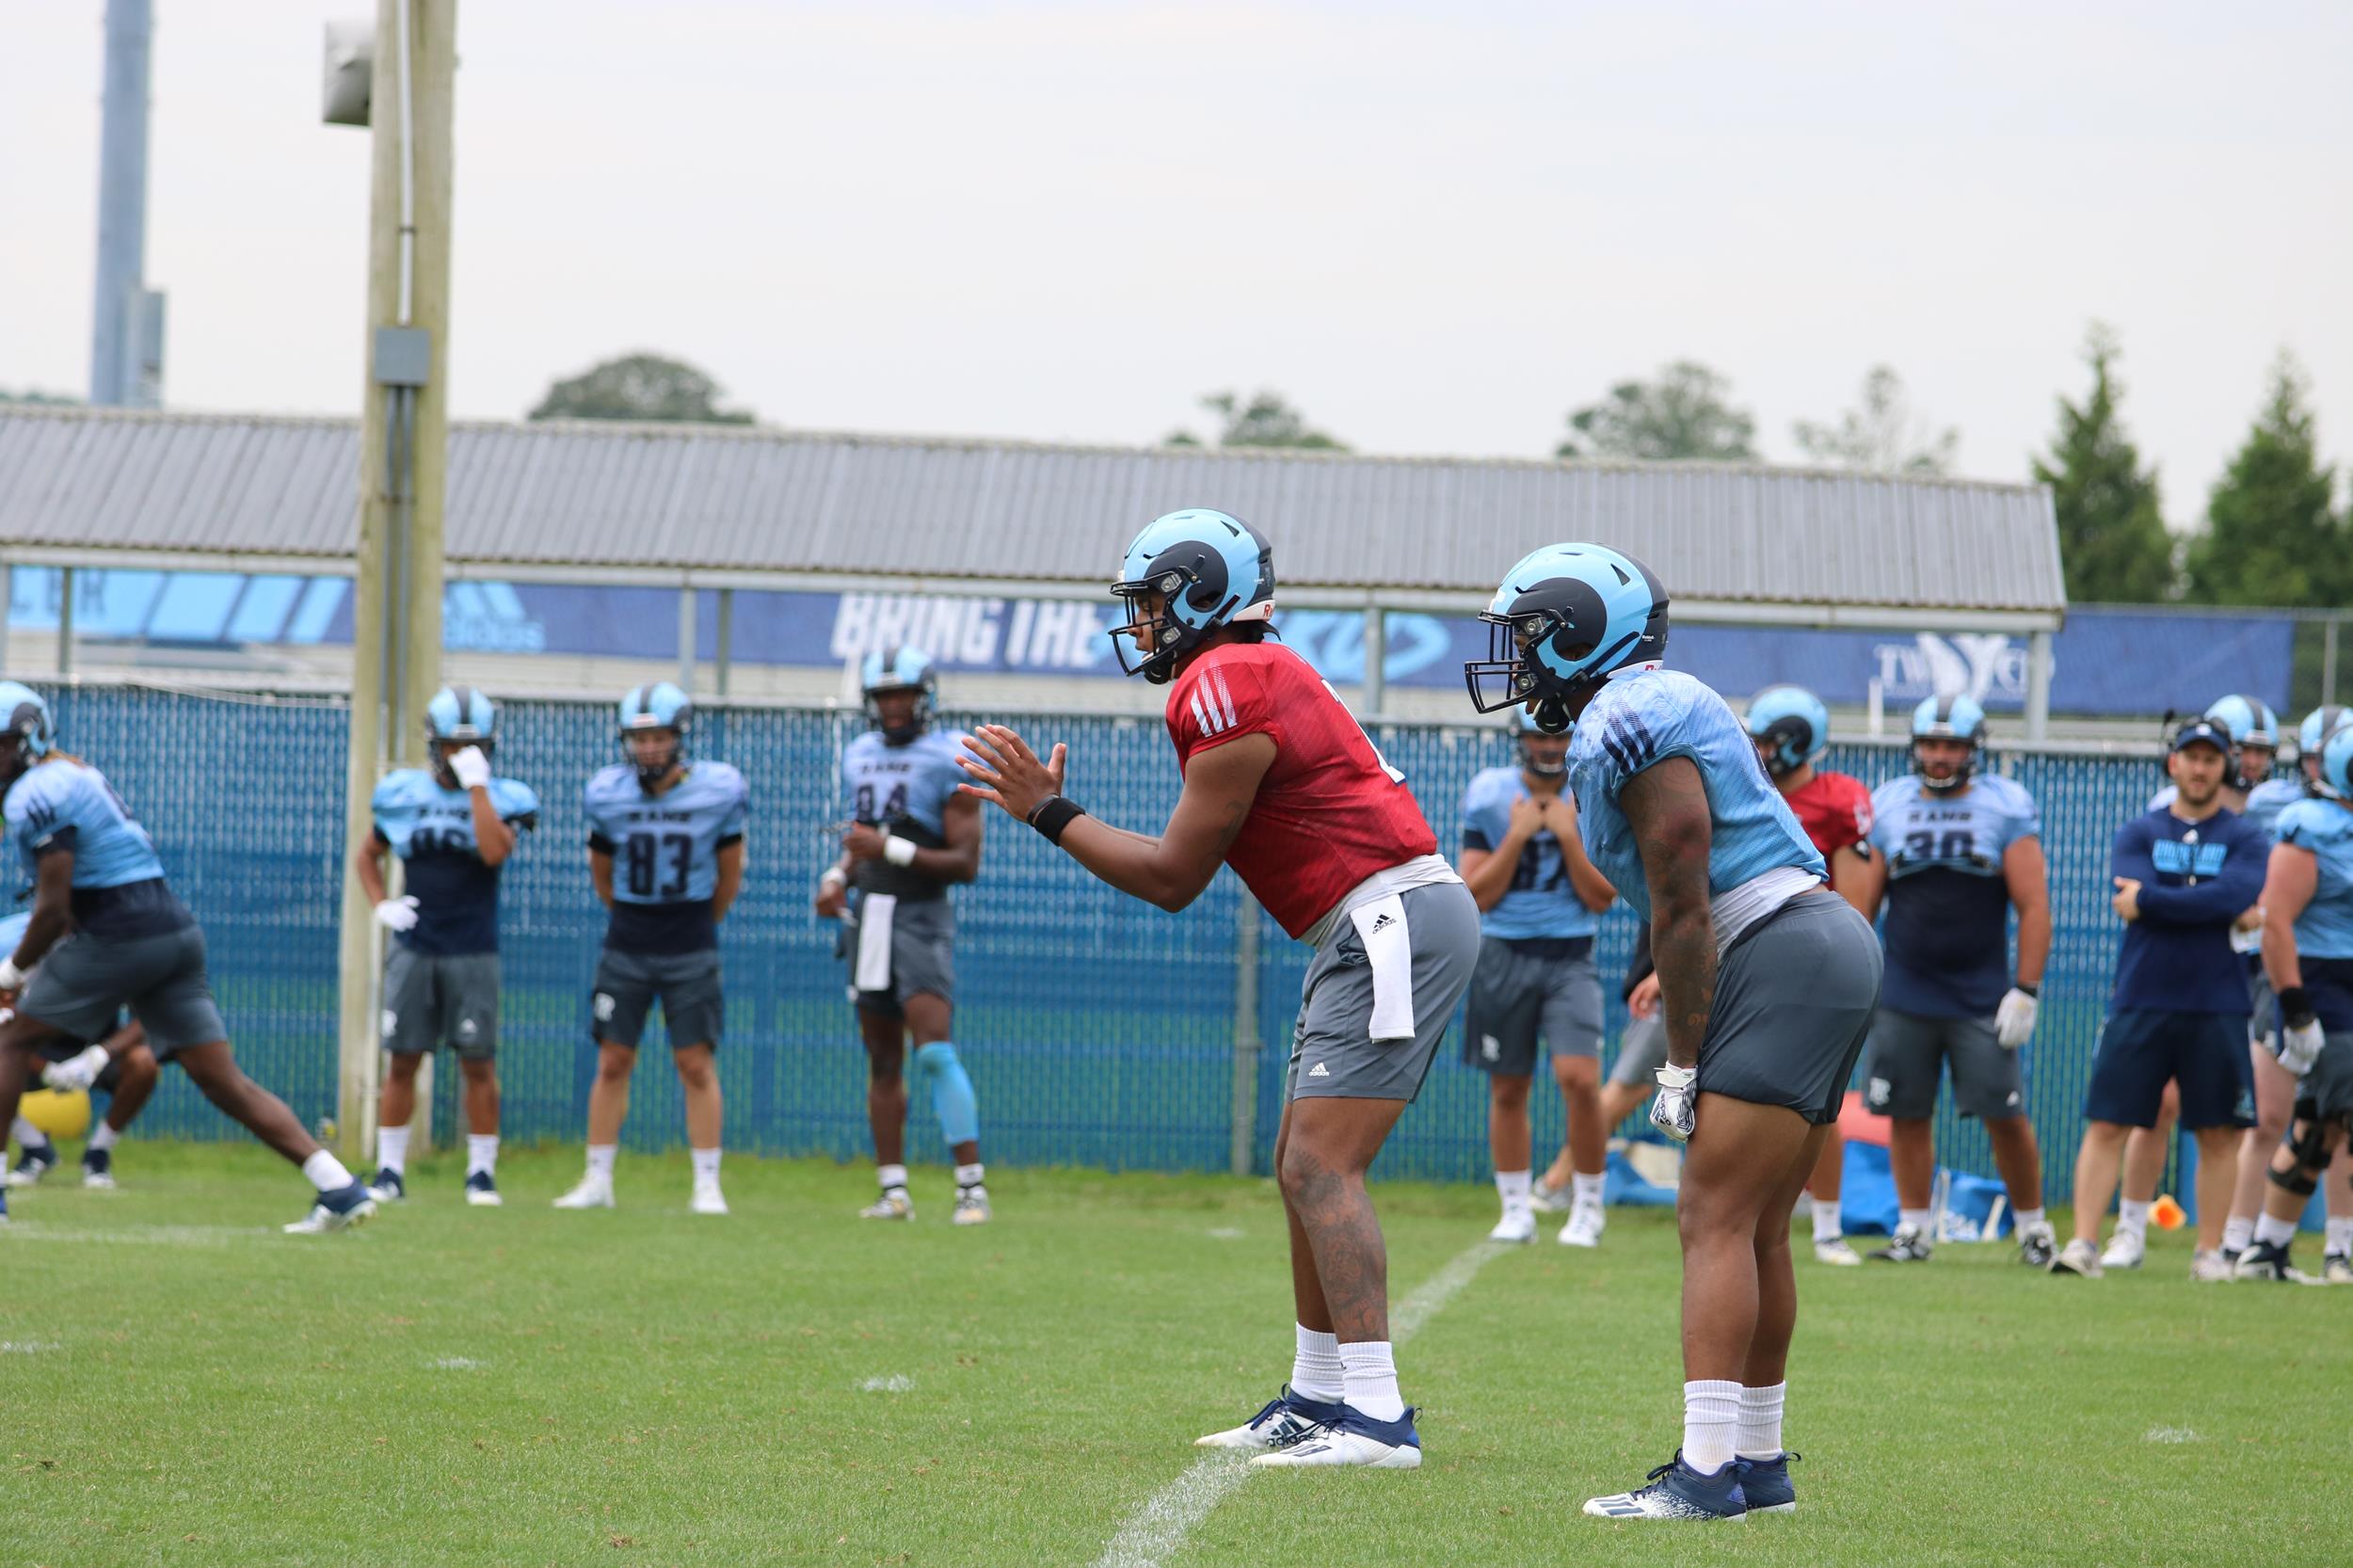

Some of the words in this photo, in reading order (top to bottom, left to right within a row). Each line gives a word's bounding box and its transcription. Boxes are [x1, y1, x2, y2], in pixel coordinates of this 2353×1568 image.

[830, 593, 1004, 665] BRING
[628, 833, 693, 895] 83
[1372, 918, 1398, 935] adidas
